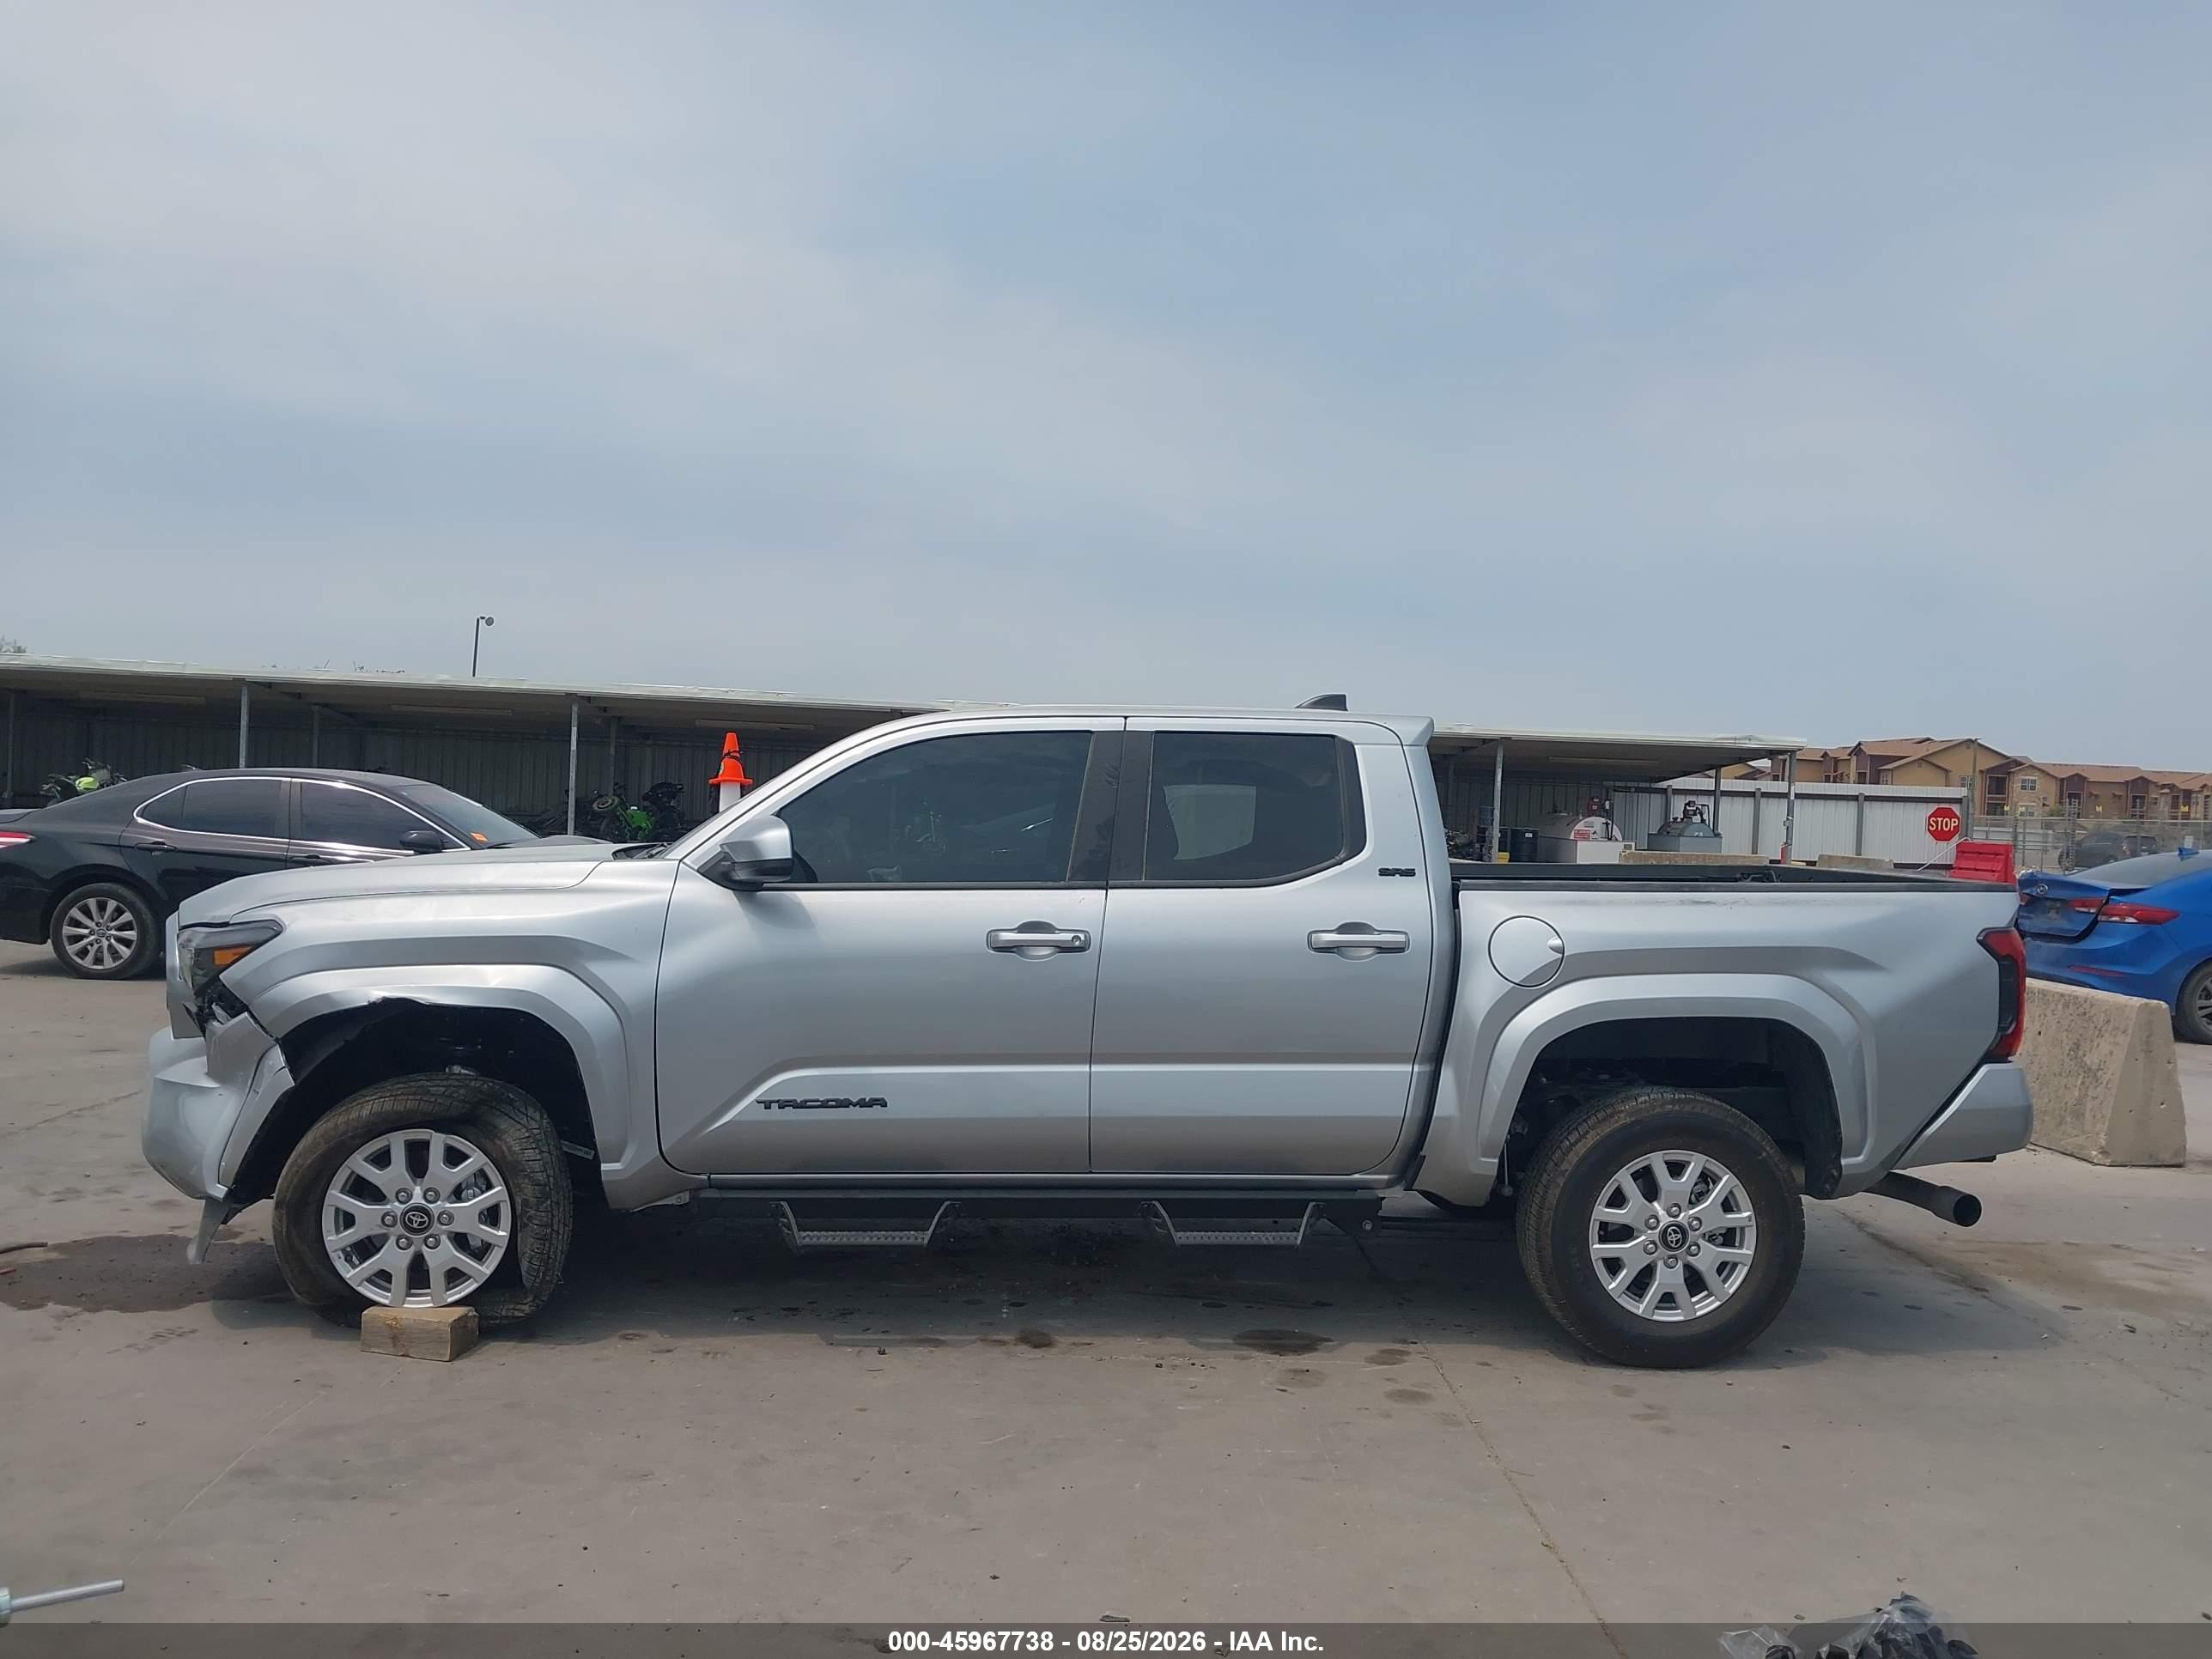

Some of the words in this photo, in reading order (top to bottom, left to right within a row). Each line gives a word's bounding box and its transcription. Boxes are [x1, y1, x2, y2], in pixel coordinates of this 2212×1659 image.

[1929, 817, 1959, 831] STOP
[1378, 867, 1416, 877] SR5
[756, 1097, 888, 1109] TACOMA
